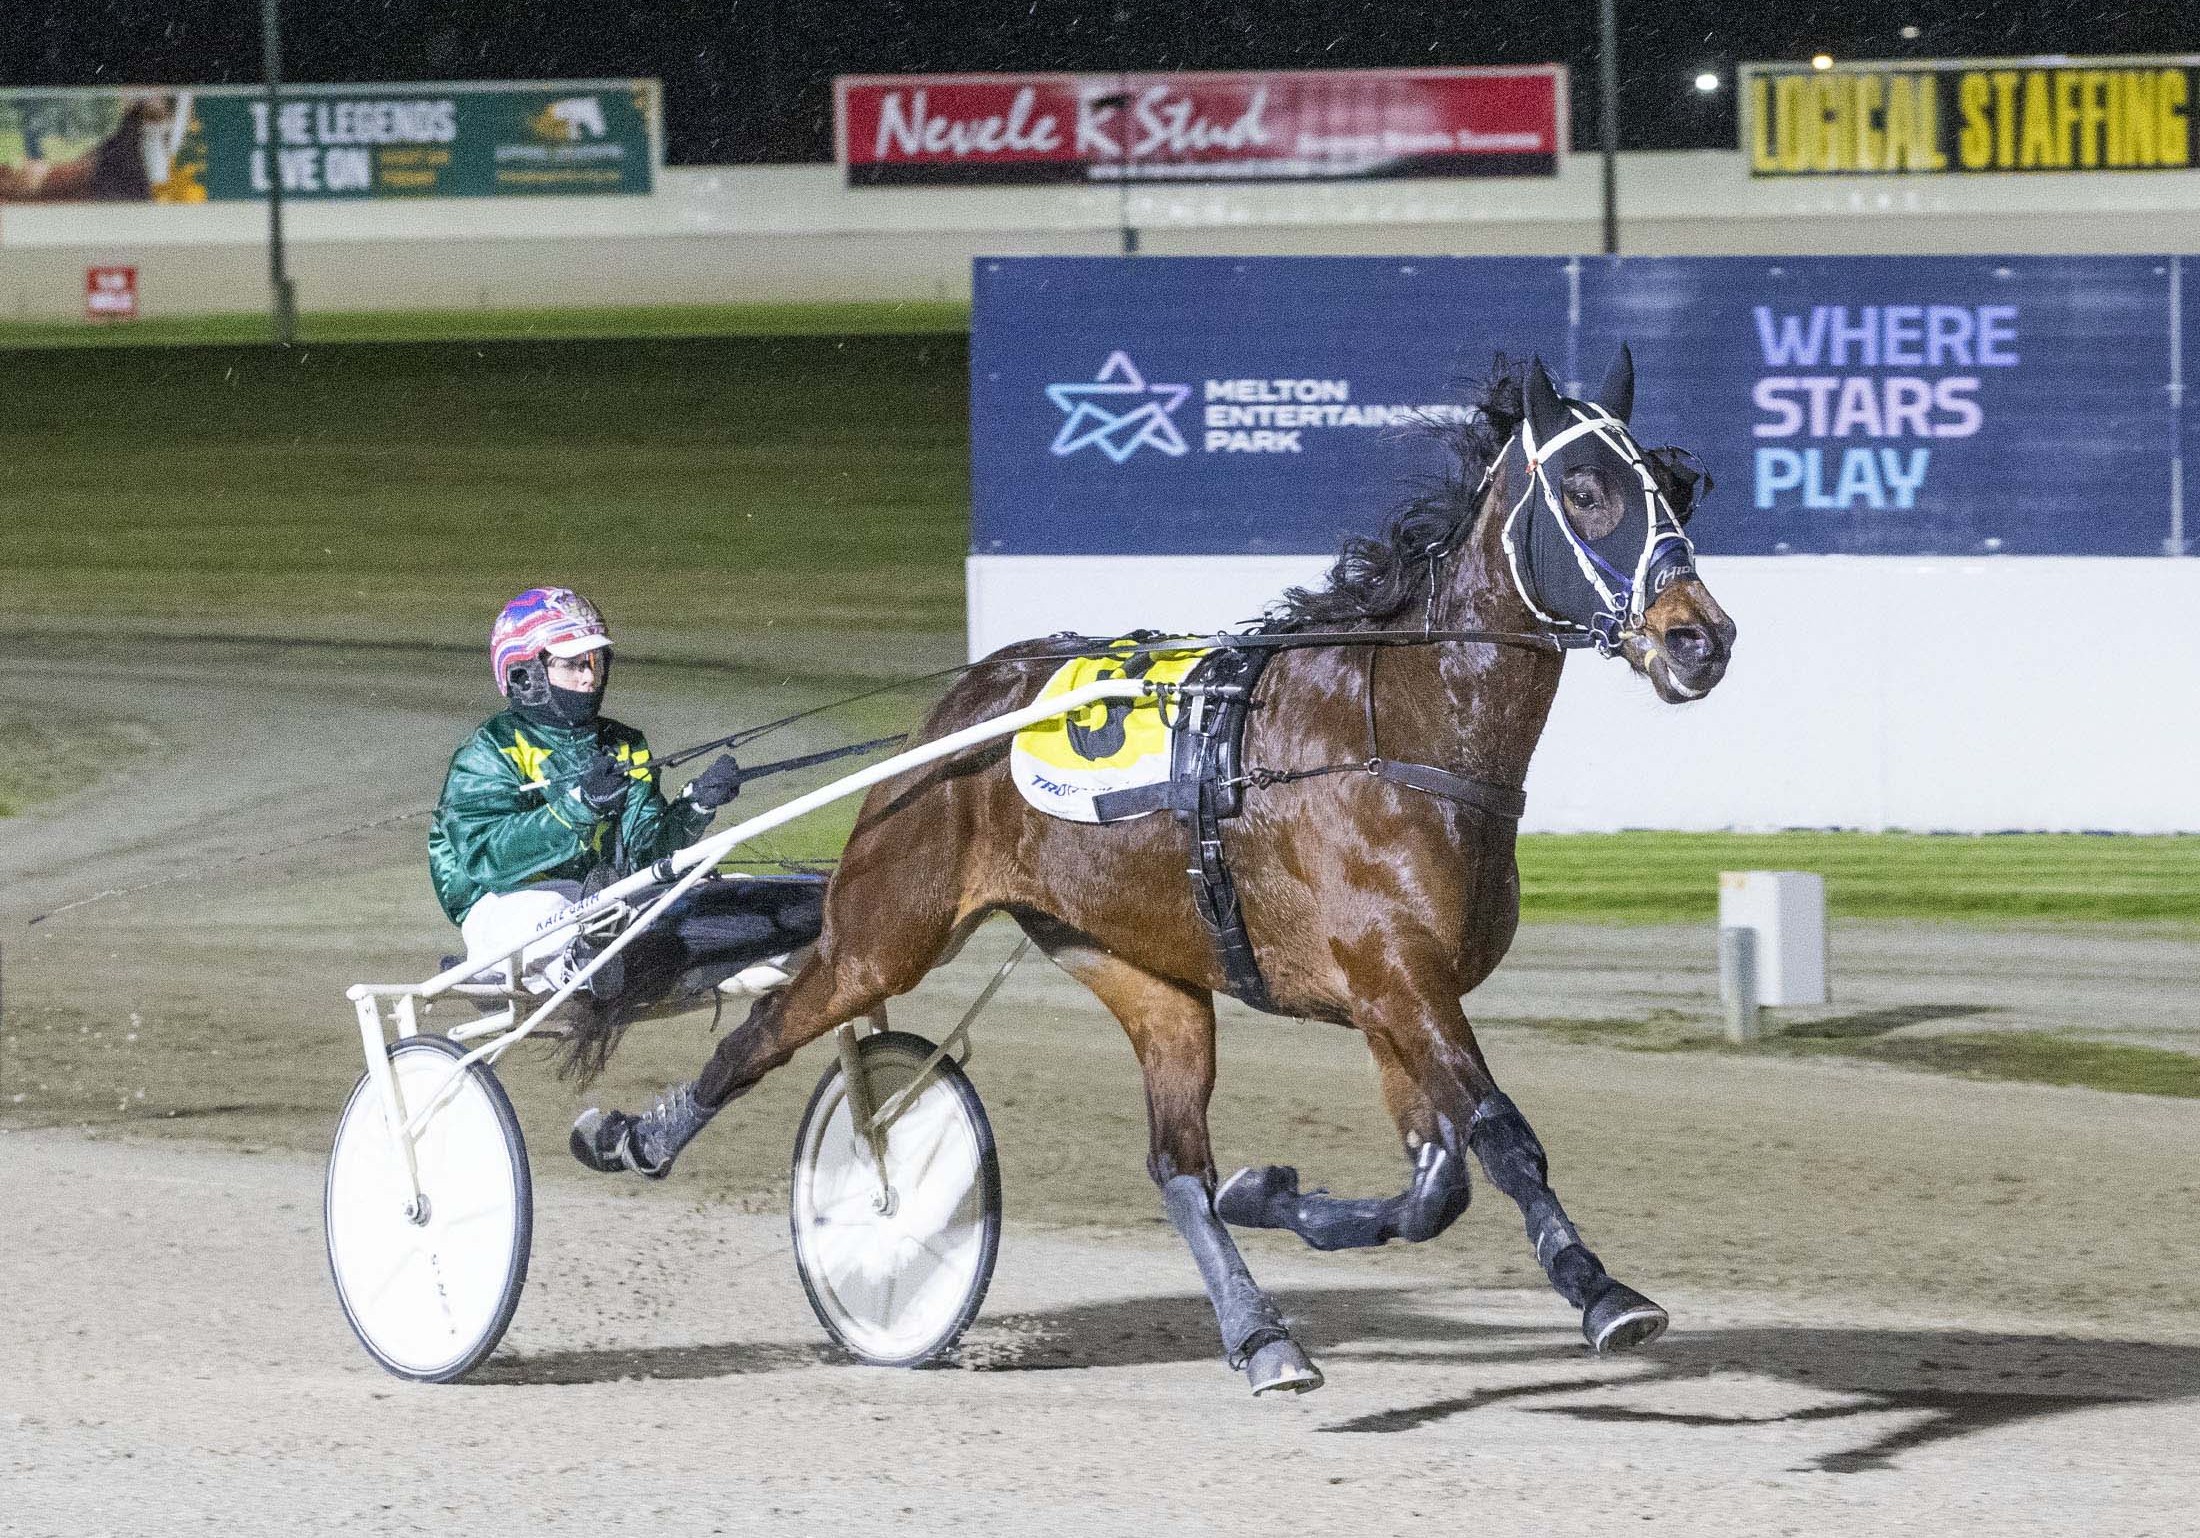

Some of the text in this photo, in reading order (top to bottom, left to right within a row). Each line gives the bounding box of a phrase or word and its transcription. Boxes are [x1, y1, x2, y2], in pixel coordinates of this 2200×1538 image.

[317, 100, 458, 143] LEGENDS
[875, 86, 1062, 159] Nevele
[1130, 84, 1271, 158] Stud
[1752, 69, 2189, 171] LOGICAL STAFFING
[250, 149, 320, 192] LVE
[324, 148, 371, 192] ON
[1754, 305, 2020, 366] WHERE
[1205, 379, 1348, 402] MELTON
[1205, 404, 1488, 427] ENTERTAINMEN
[1753, 376, 1983, 437] STARS
[1205, 429, 1302, 452] PARK
[1755, 447, 1930, 509] PLAY
